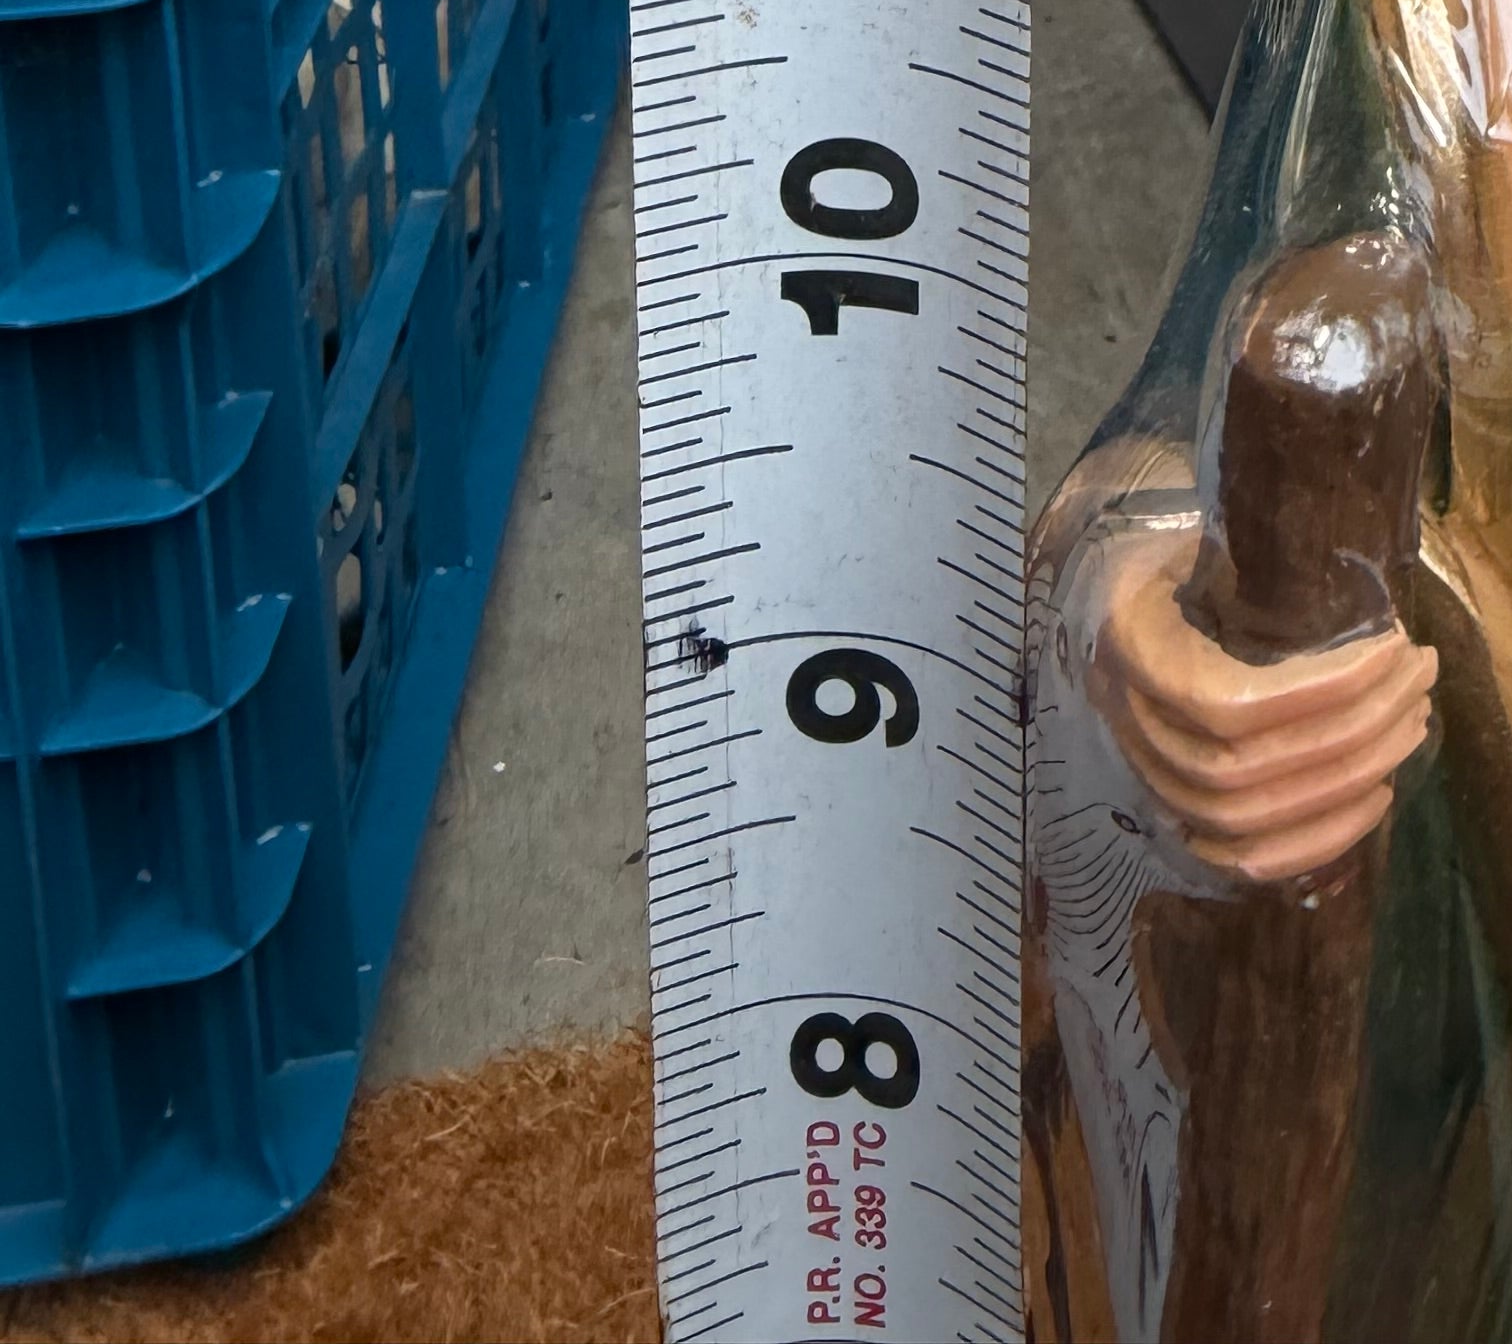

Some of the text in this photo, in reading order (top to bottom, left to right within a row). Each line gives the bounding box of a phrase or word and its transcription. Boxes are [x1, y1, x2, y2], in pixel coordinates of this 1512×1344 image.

[780, 137, 919, 336] 10
[785, 647, 920, 748] 9
[789, 1011, 921, 1109] 8
[806, 1120, 842, 1324] P.R. APP'D
[853, 1120, 888, 1329] NO. 339 TC
